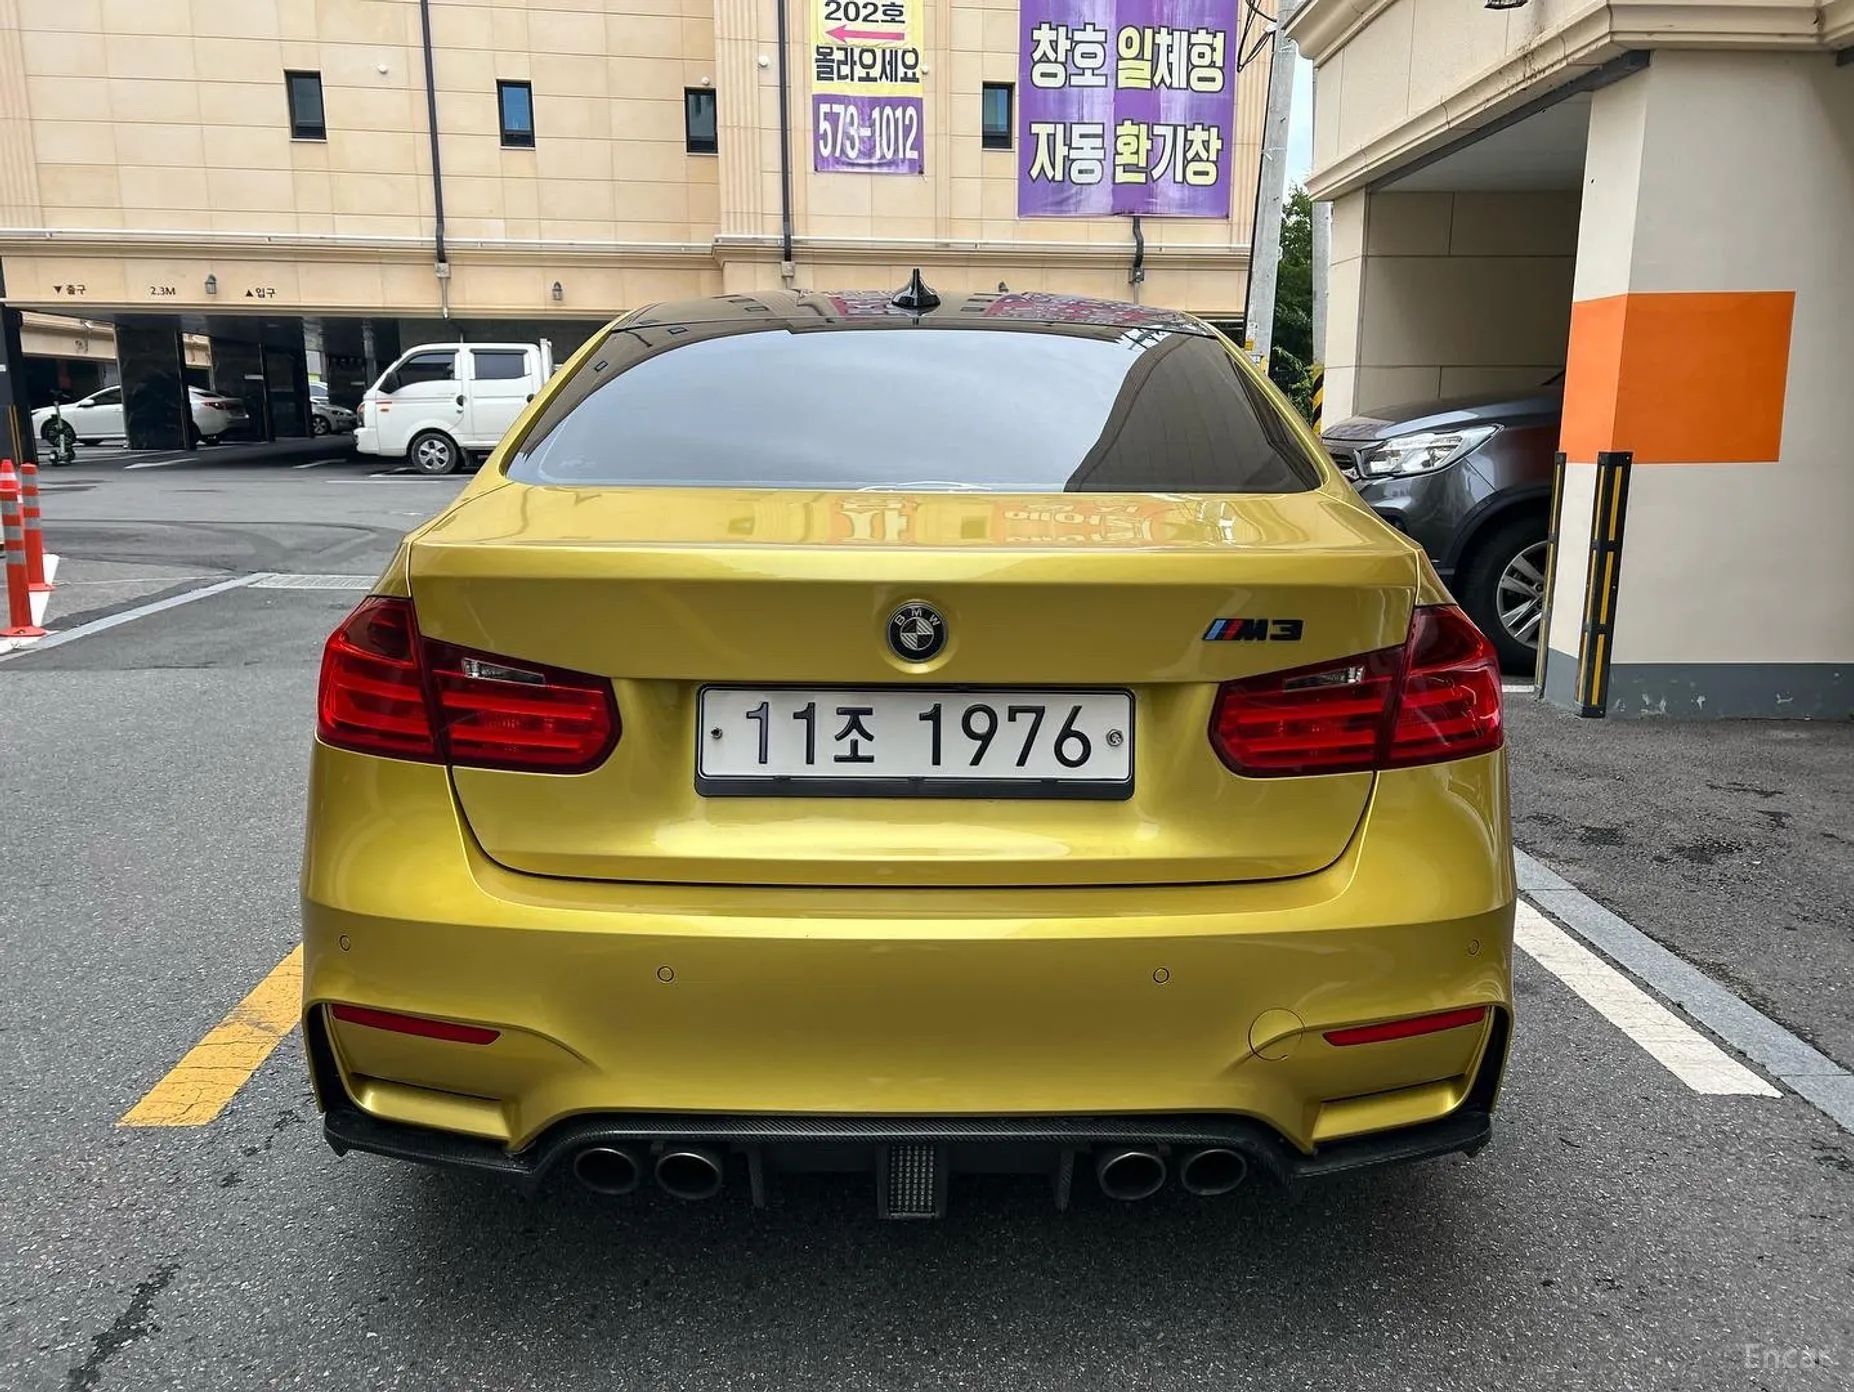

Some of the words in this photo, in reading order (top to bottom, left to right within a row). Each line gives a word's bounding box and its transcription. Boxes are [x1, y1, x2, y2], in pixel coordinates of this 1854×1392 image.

[824, 1, 906, 24] 202호
[1031, 22, 1108, 88] 창호
[1116, 25, 1226, 93] 일체형
[819, 103, 918, 160] 573-1012
[1028, 121, 1105, 186] 자동
[1113, 118, 1223, 186] 환기창
[66, 284, 86, 295] 출구
[150, 286, 176, 295] 2.3M
[255, 287, 276, 298] 입구
[893, 607, 941, 626] BMW
[745, 701, 875, 765] 11조
[918, 702, 1092, 768] 1976
